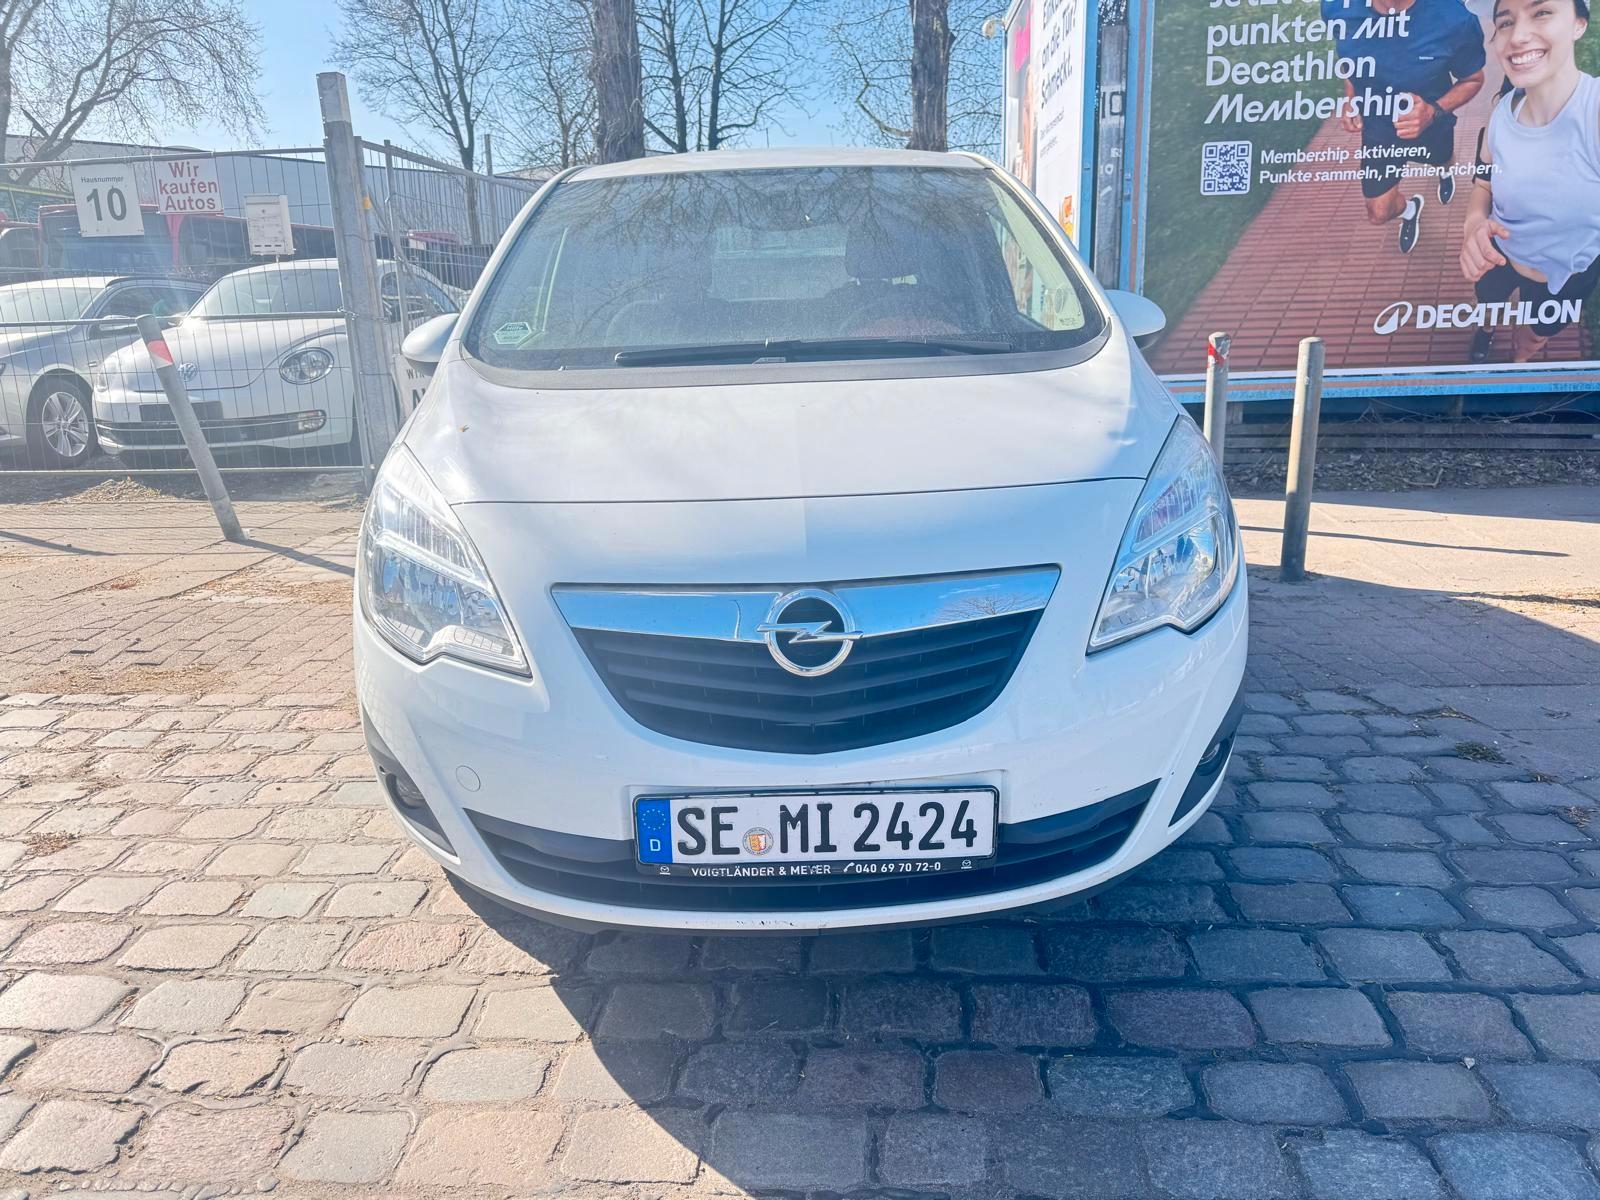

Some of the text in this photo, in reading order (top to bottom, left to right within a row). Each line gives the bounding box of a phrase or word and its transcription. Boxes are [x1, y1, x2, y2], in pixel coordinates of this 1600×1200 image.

[1206, 13, 1347, 54] punkten
[1205, 50, 1376, 86] Decathlon
[1203, 86, 1415, 124] Membership
[1260, 144, 1432, 165] Membership aktivieren,
[80, 175, 124, 184] Hausnummer
[168, 161, 200, 178] Wir
[1259, 161, 1503, 184] Punkte sammeln, Prämien sichern.
[158, 178, 218, 195] kaufen
[86, 186, 128, 222] 10
[164, 195, 216, 211] Autos
[1415, 298, 1583, 330] DECATHLON
[650, 838, 661, 852] D
[677, 806, 741, 856] SE
[779, 803, 838, 854] MI
[853, 800, 978, 853] 2424
[691, 865, 775, 877] VOIGTLÄNDER
[778, 866, 787, 876] &
[855, 862, 877, 874] 040
[880, 862, 894, 873] 69
[899, 862, 912, 873] 70
[915, 861, 942, 872] 72-0
